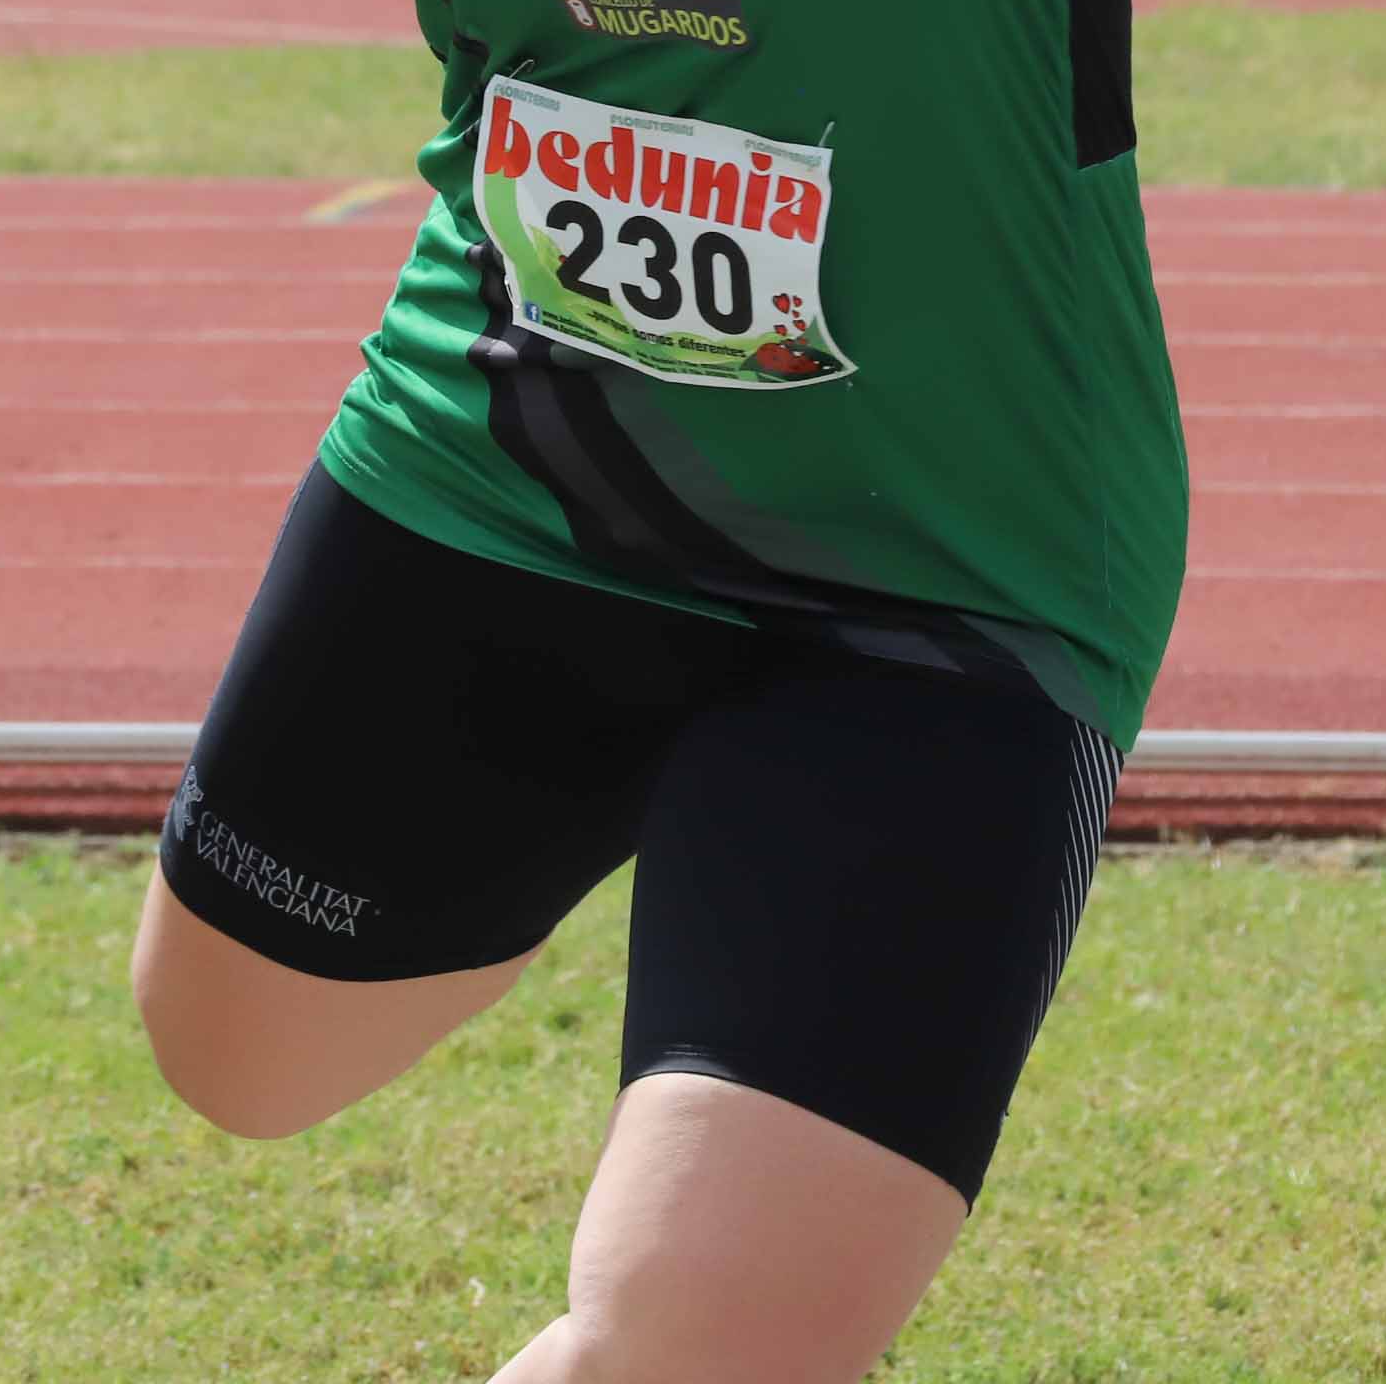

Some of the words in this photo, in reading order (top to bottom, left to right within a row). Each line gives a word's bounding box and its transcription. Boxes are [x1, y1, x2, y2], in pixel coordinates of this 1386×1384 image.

[592, 6, 747, 46] MUGARDOS
[484, 95, 822, 244] bedunia
[545, 199, 753, 335] 230
[678, 337, 747, 358] diferentes
[196, 827, 356, 937] VALENCIANA
[200, 810, 371, 917] GENERALITAT
